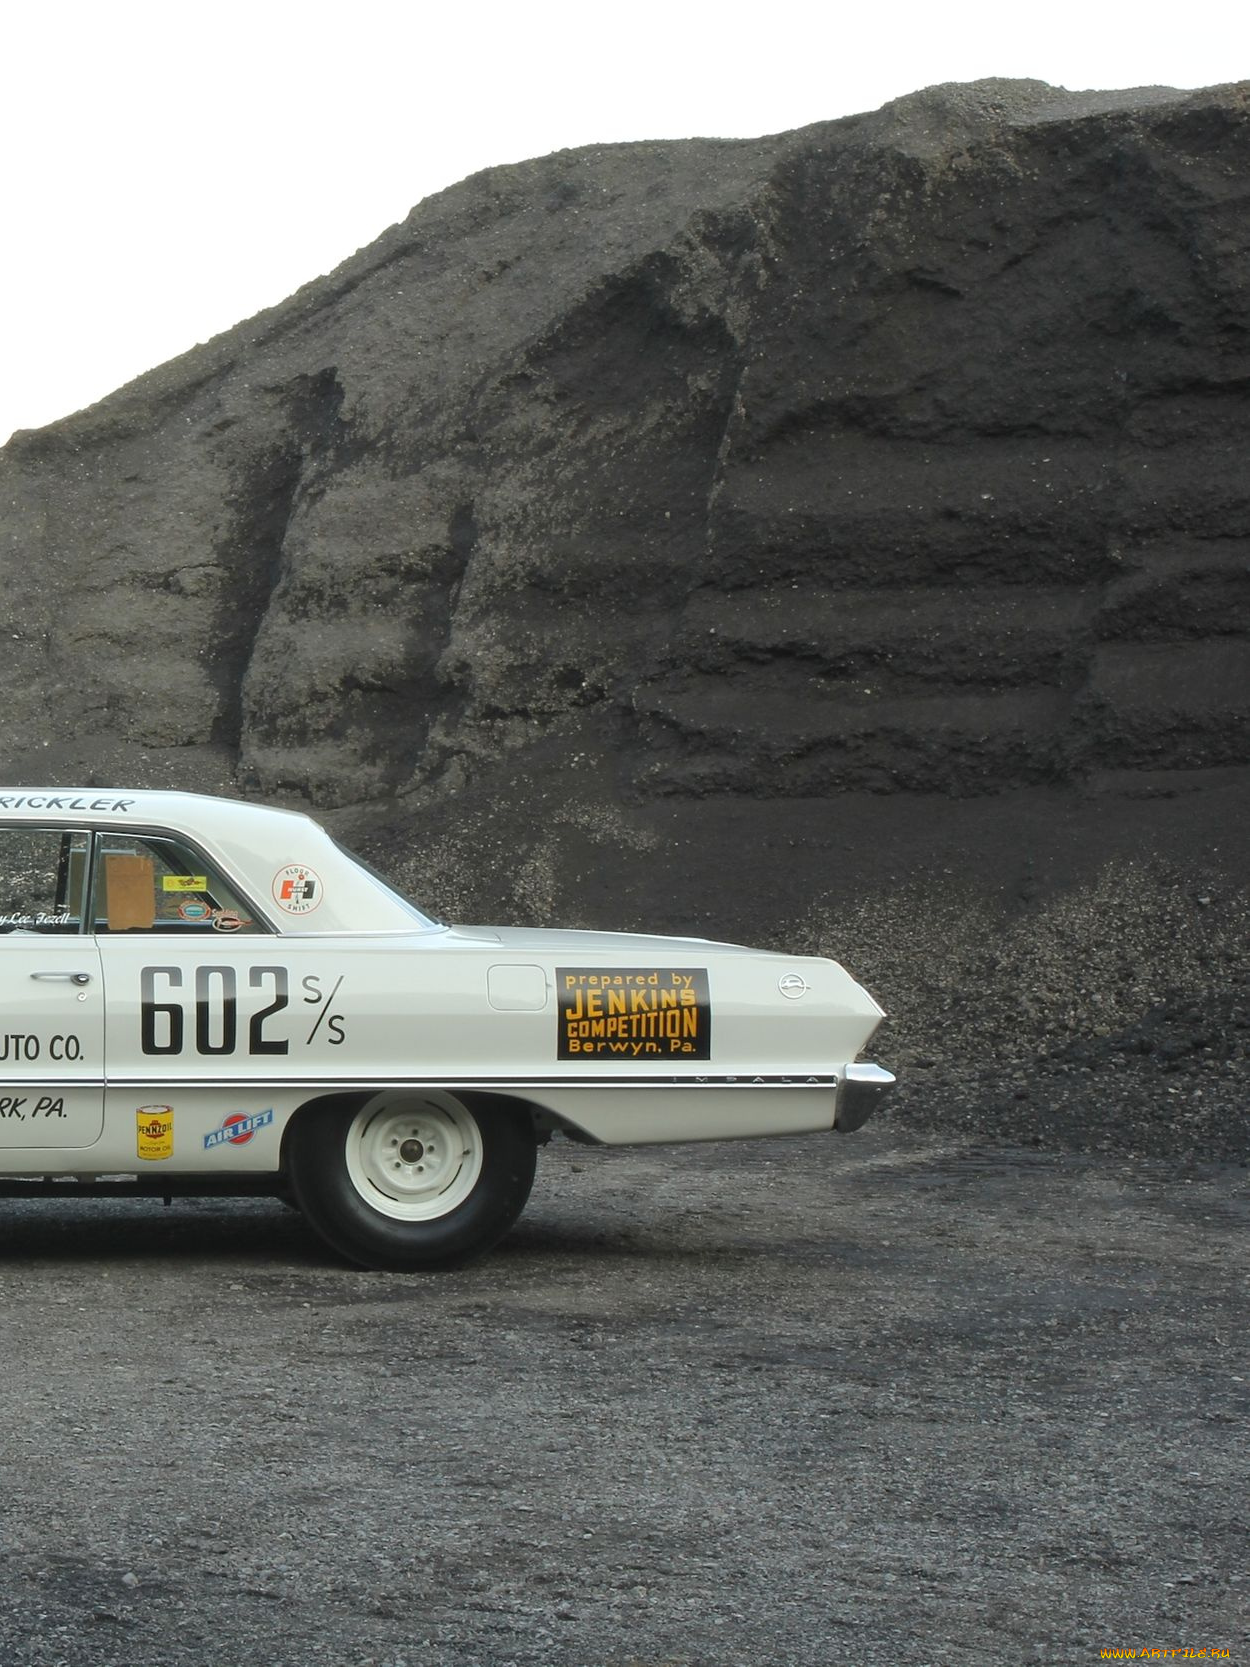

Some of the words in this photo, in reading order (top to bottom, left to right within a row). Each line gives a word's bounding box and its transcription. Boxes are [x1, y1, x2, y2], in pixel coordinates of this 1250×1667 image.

[565, 973, 658, 989] prepared
[671, 972, 693, 989] by
[140, 965, 289, 1056] 602
[565, 989, 696, 1021] JENKINS
[567, 1007, 697, 1038] COMPETITION
[49, 1034, 84, 1061] CO.
[568, 1039, 662, 1055] Berwyn,
[670, 1039, 697, 1053] Pa.
[671, 1075, 820, 1084] IMPALA
[31, 1096, 68, 1118] PA.
[138, 1122, 173, 1135] PENNZOIL
[206, 1127, 234, 1147] AIR
[237, 1111, 271, 1134] LIFT
